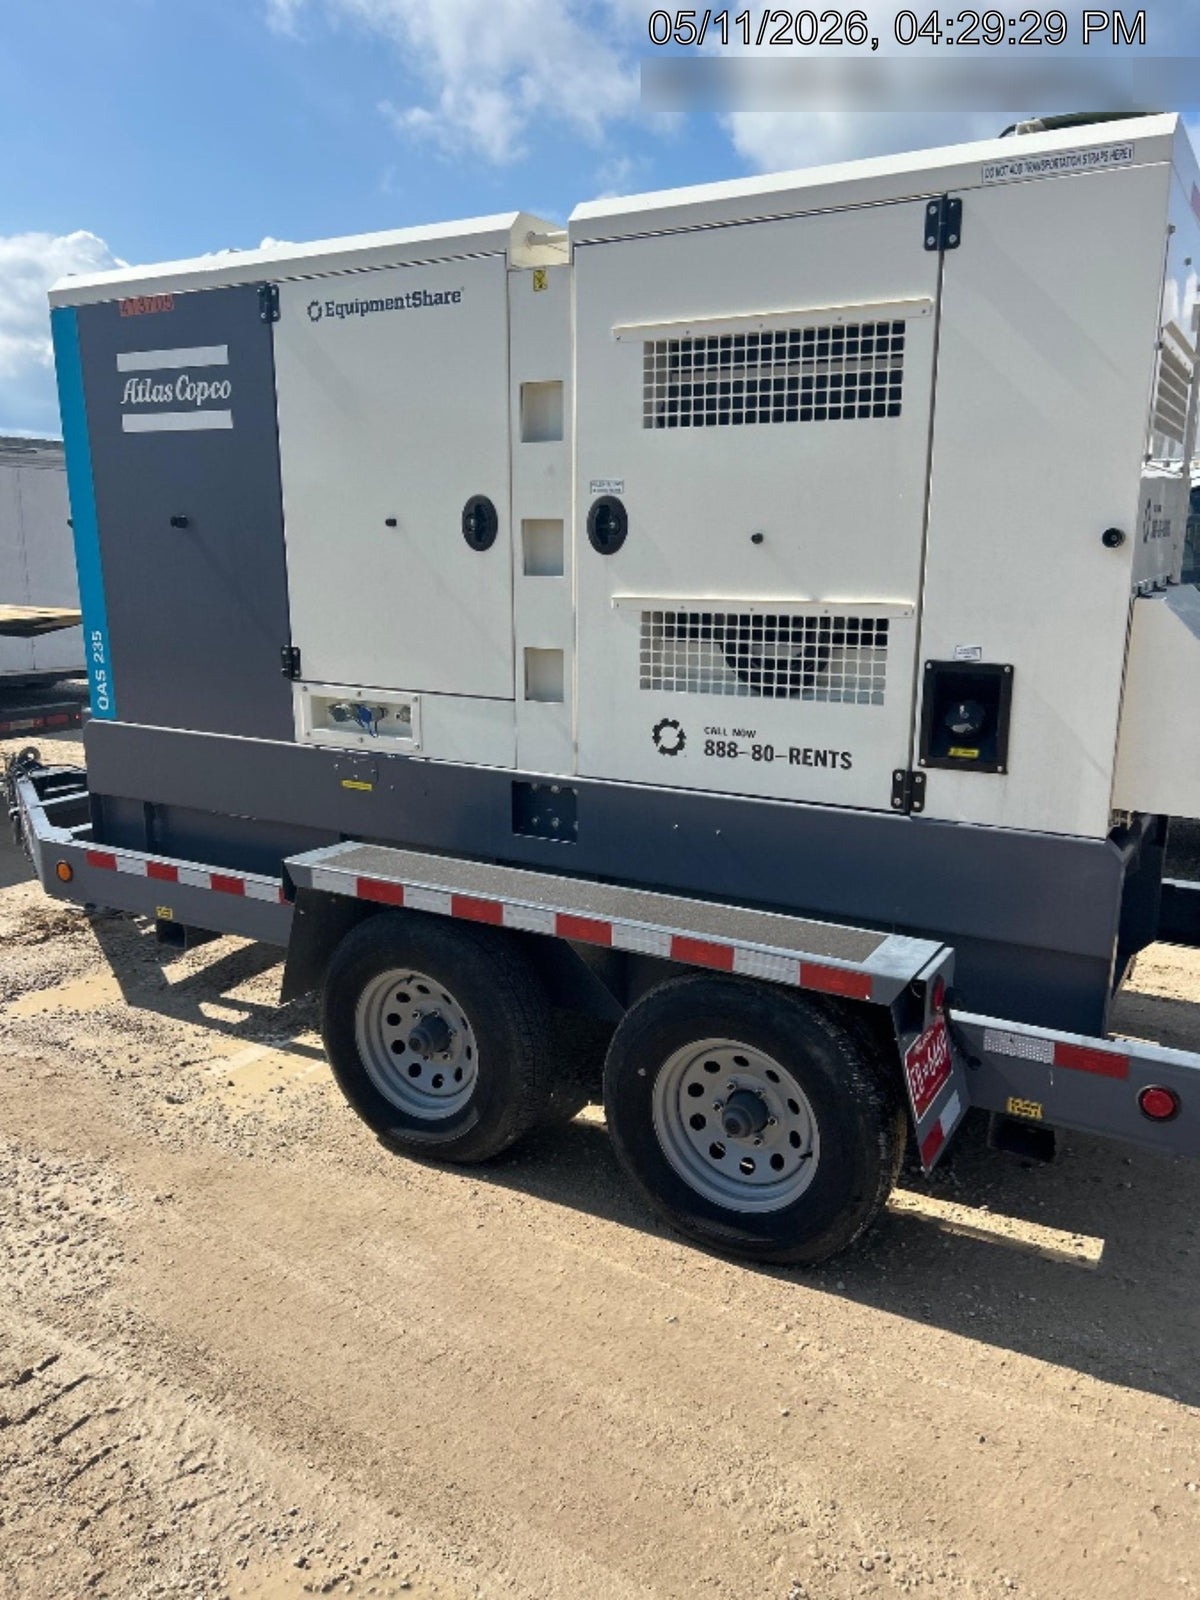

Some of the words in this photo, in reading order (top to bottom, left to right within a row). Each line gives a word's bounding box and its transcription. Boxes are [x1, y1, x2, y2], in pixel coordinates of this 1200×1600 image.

[995, 164, 1008, 177] NOT
[1024, 156, 1081, 173] TRANSPORTATION
[1082, 151, 1109, 166] STRAPS
[324, 288, 461, 319] EquipmentShare
[120, 377, 173, 404] Atlas
[176, 374, 232, 406] Copco
[91, 630, 105, 663] 235
[95, 670, 109, 710] QAS
[703, 725, 728, 737] CALL
[732, 727, 757, 739] NOW
[704, 739, 853, 770] 888-80-RENTS
